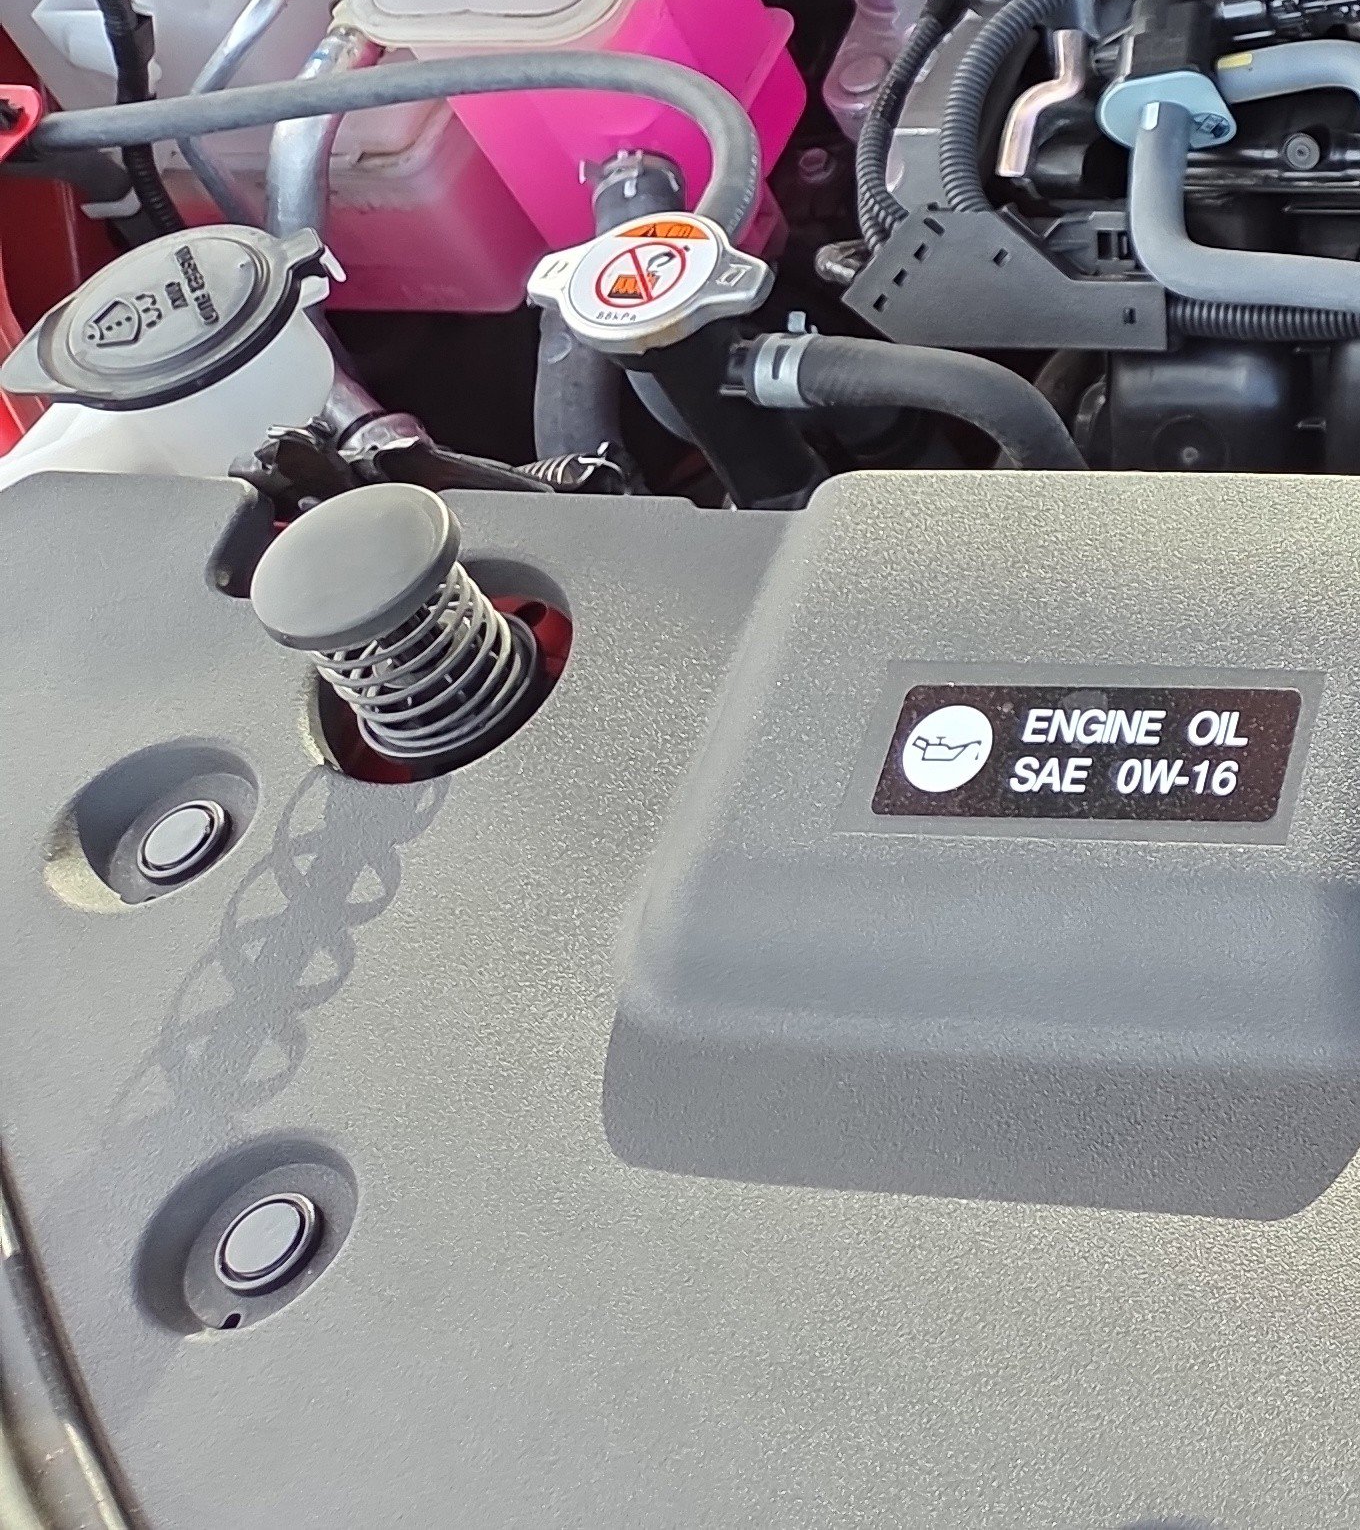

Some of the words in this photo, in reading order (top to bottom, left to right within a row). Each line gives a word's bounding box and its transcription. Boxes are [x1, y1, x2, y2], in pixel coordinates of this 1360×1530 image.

[1022, 708, 1167, 746] ENGINE
[1187, 710, 1250, 747] OIL
[1010, 757, 1093, 793] SAE
[1116, 758, 1239, 796] 0W-16
